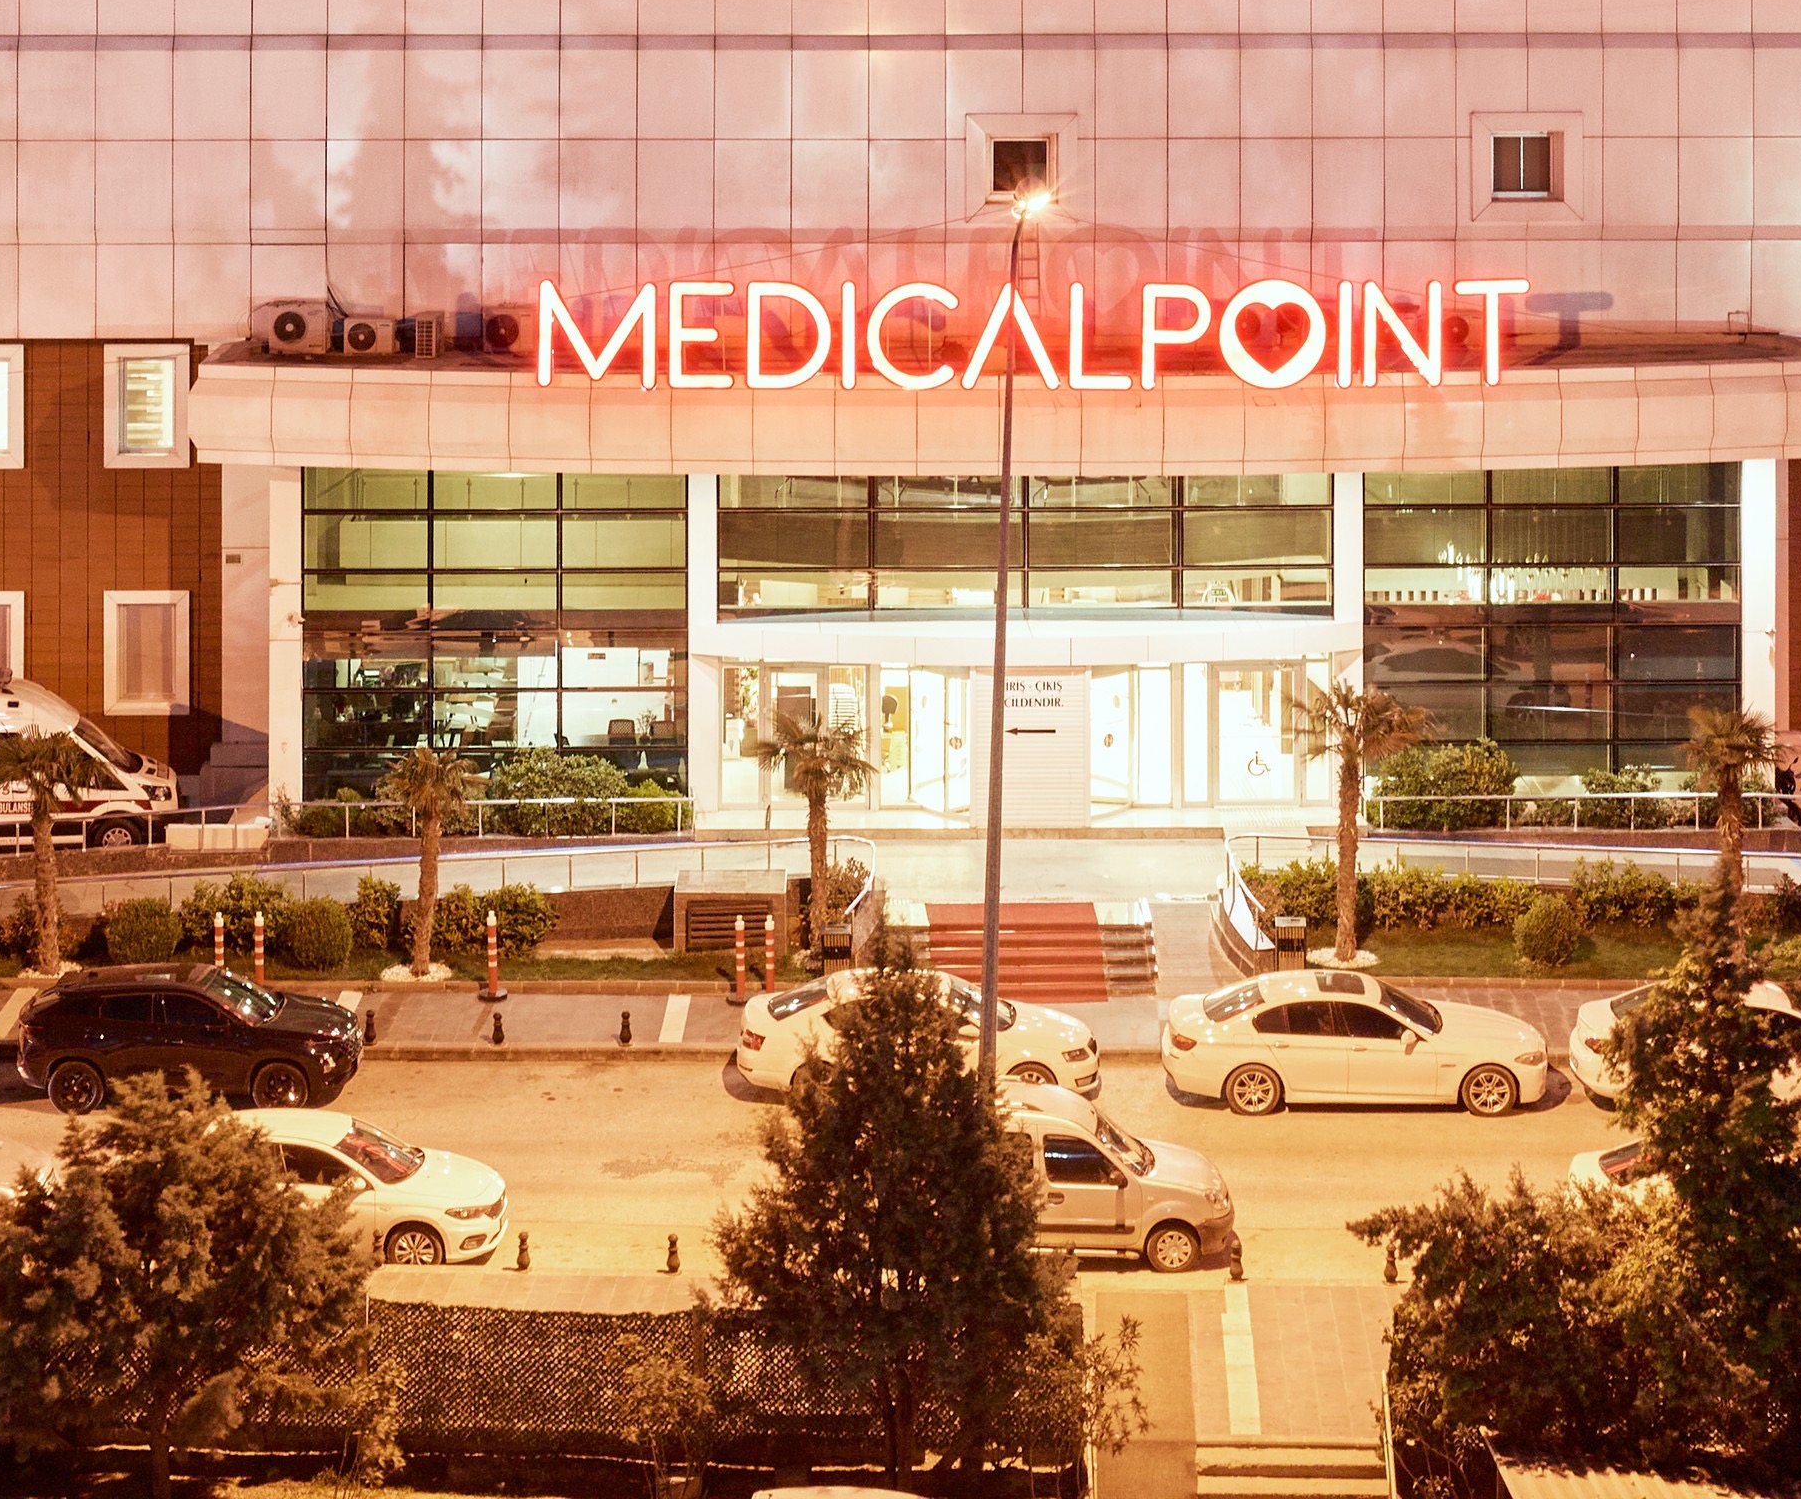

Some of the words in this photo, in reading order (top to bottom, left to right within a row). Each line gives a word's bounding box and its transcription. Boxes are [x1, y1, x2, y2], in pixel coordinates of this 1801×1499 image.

[536, 279, 1531, 391] MEDICALPOINT
[1006, 679, 1025, 693] İRİŞ
[1035, 680, 1063, 693] ÇIKIŞ
[1004, 695, 1064, 707] CİLDENDİR.
